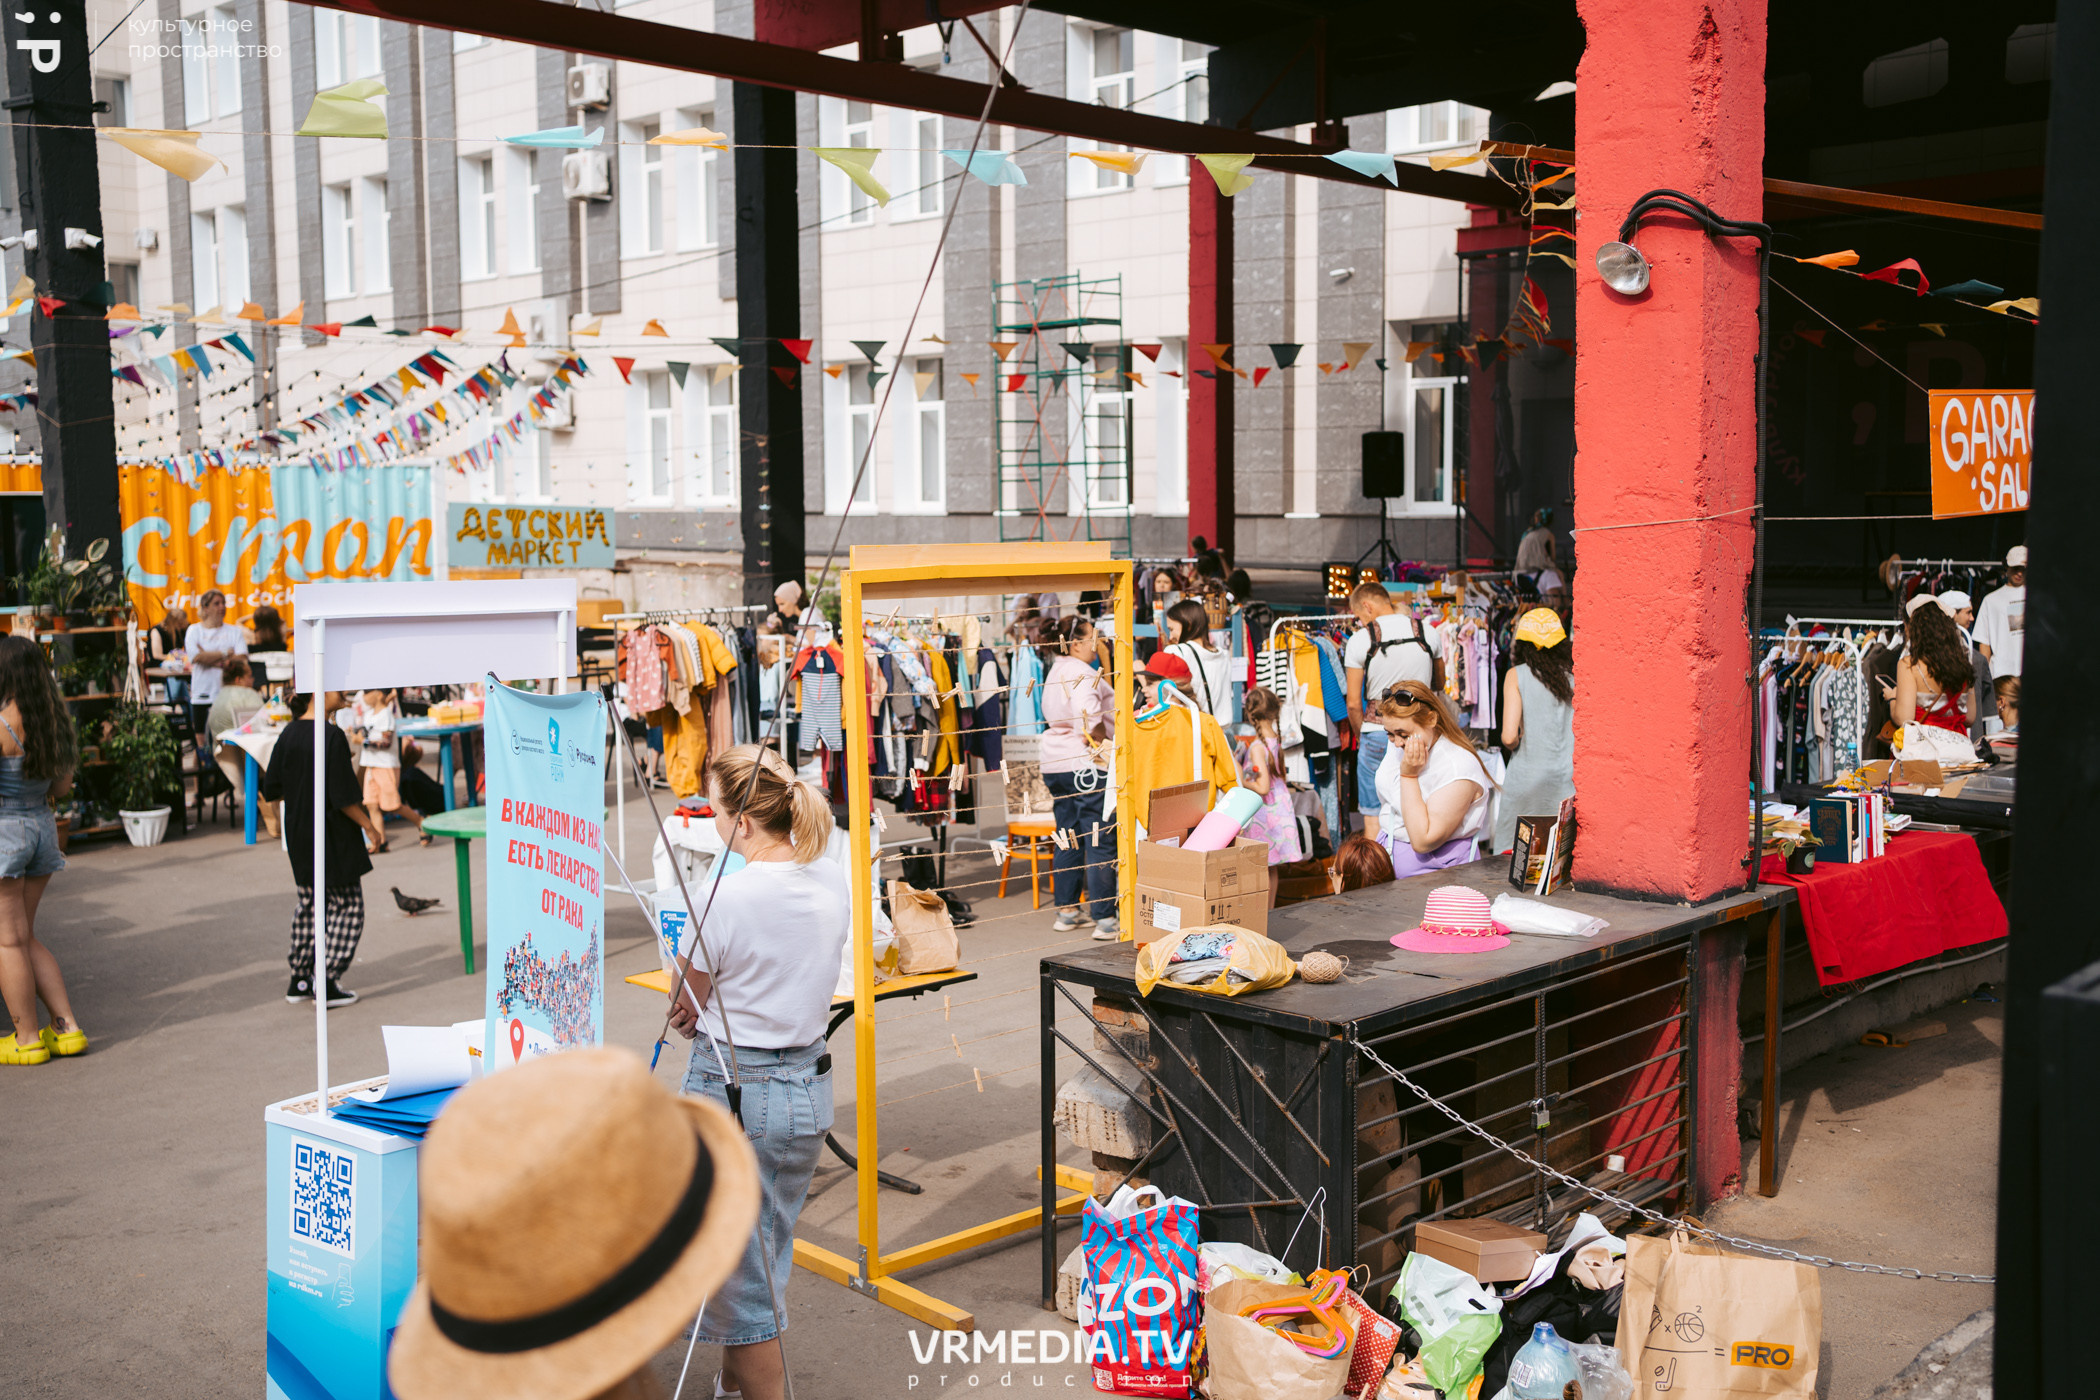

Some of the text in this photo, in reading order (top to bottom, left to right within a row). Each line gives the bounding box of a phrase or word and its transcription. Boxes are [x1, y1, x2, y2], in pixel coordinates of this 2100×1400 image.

[1766, 320, 1807, 486] кульурное
[456, 507, 610, 547] ДЕТСКИЙ
[487, 540, 582, 565] МАРКЕТ
[501, 798, 513, 822] В
[515, 800, 570, 840] КАЖДОМ
[572, 815, 586, 845] ИЗ
[507, 839, 600, 898] ЕСТЬ ЛЕКАРСТВО
[541, 888, 583, 931] ОТ РАКА
[1736, 1345, 1790, 1366] PRO
